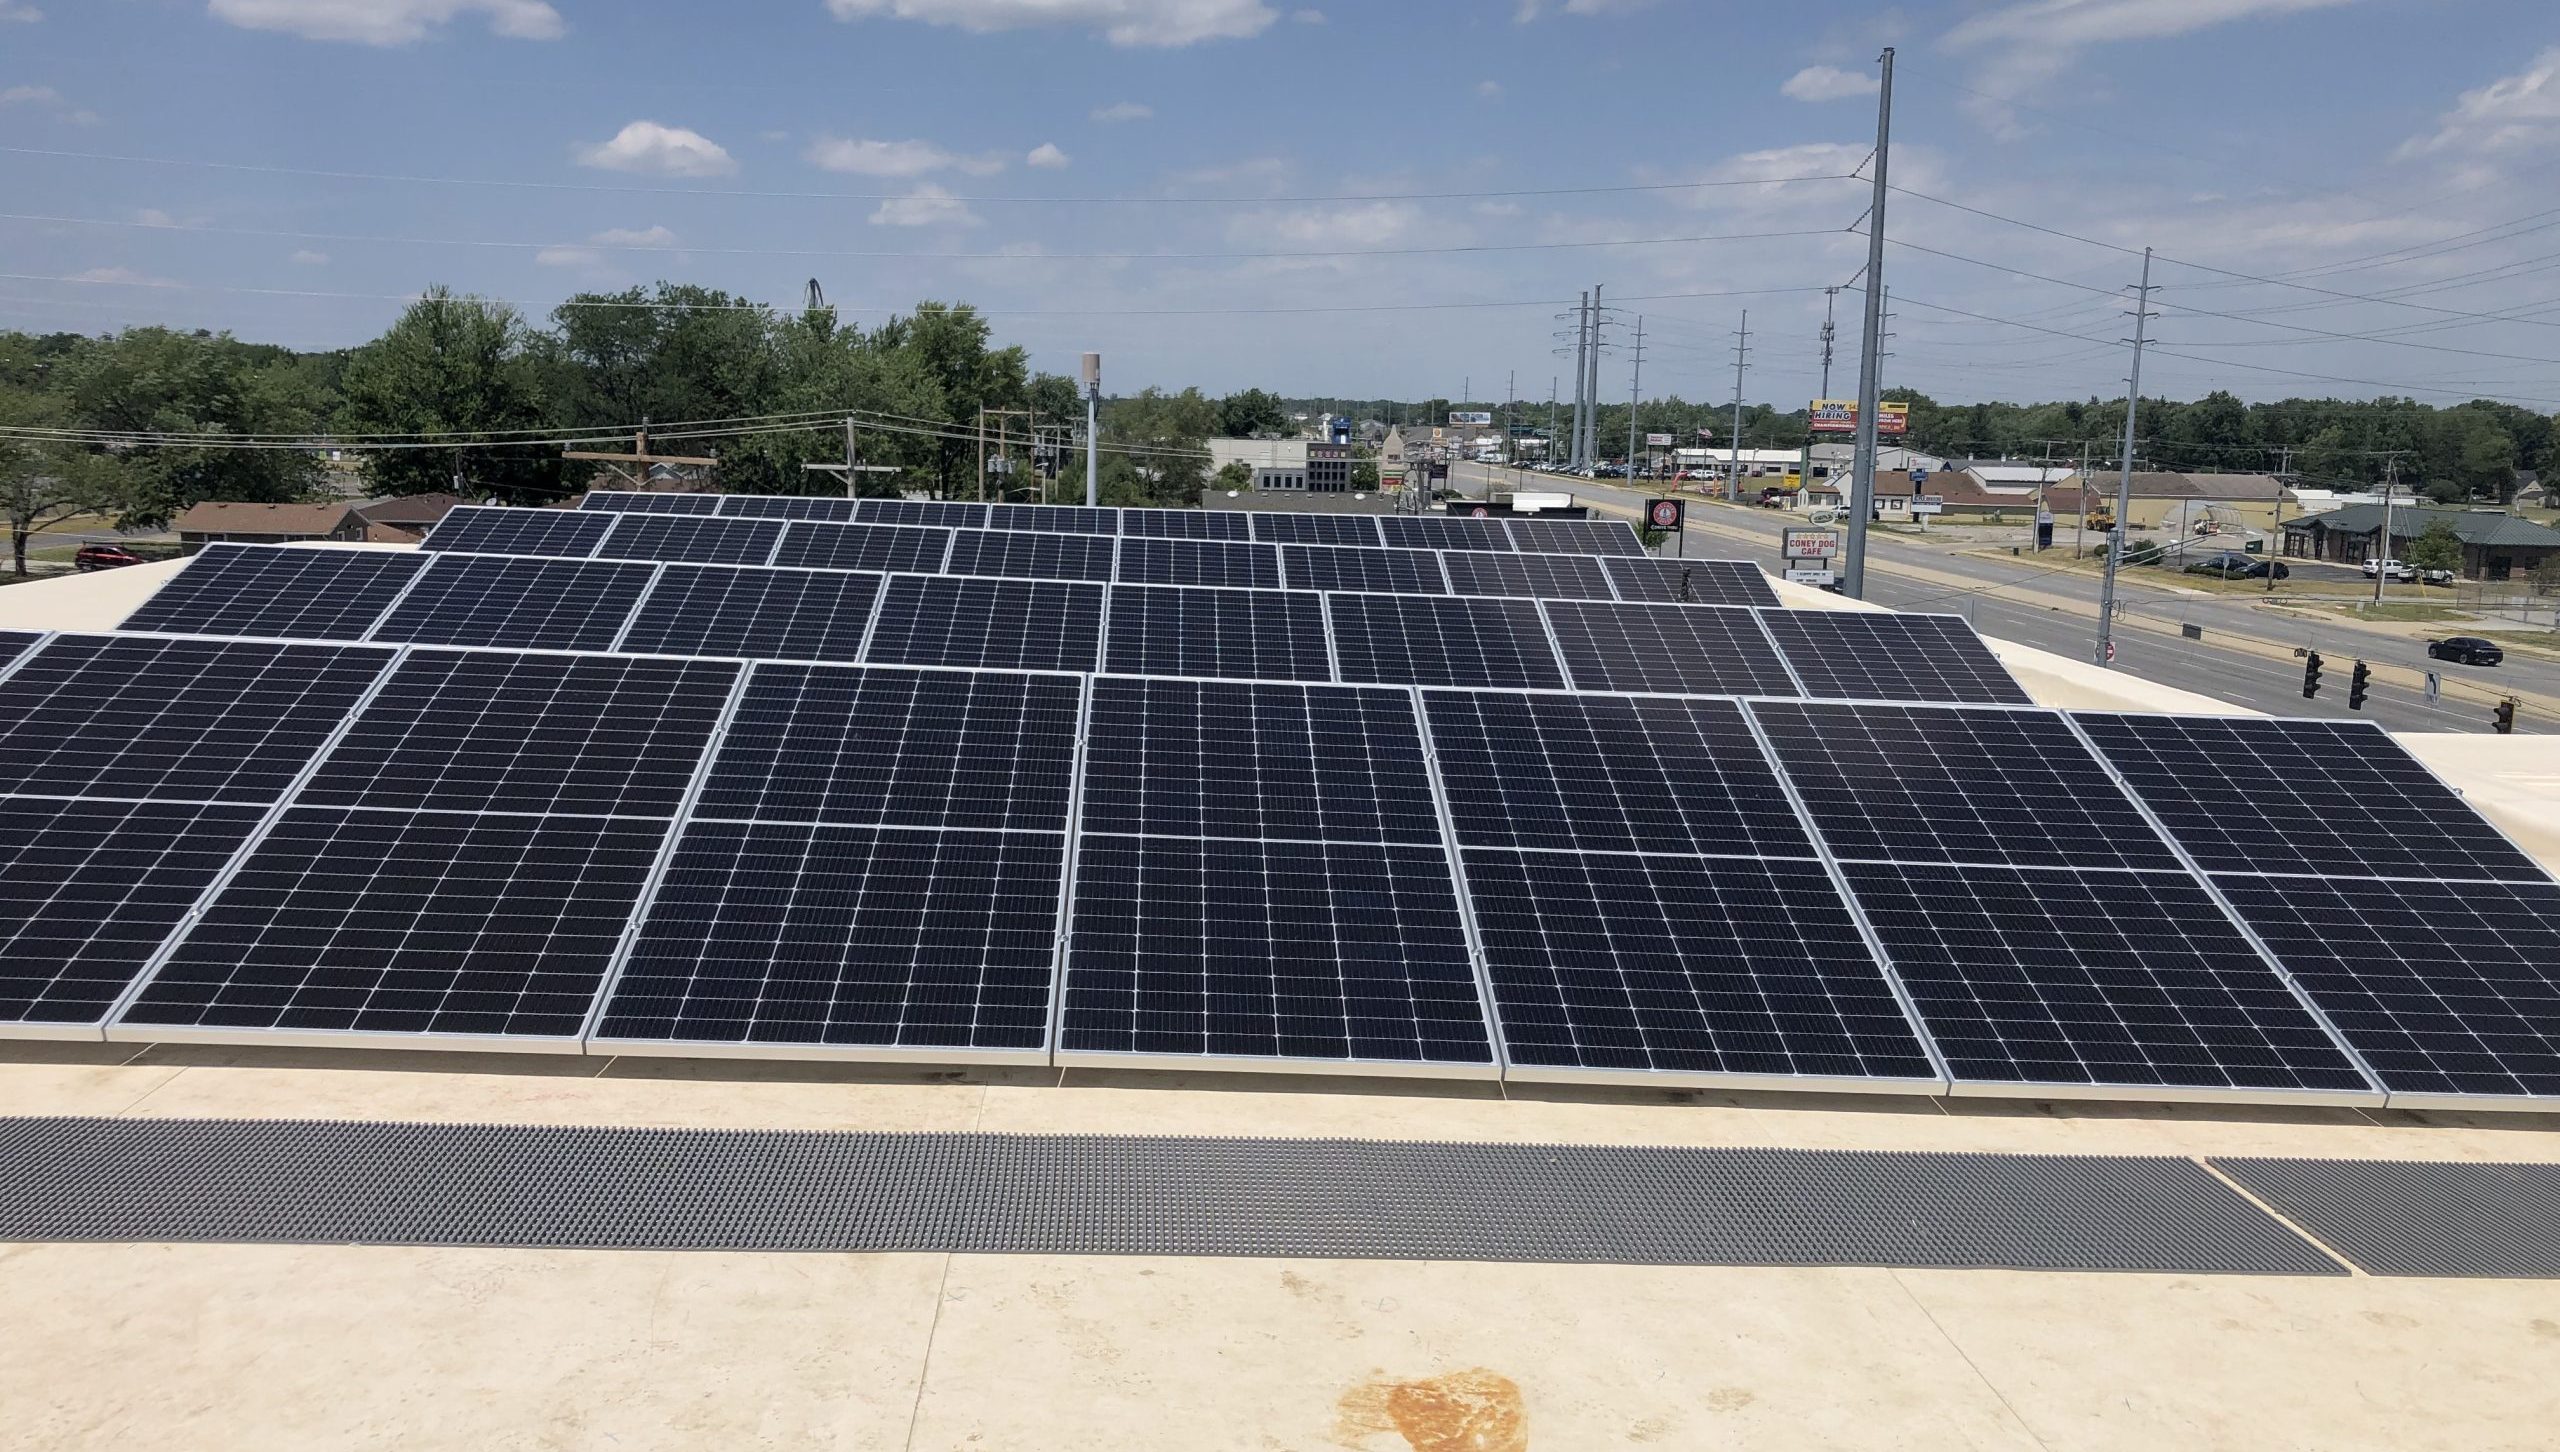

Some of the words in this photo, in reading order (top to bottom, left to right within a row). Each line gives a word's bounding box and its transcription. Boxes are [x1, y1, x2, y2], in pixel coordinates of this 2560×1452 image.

[1821, 403, 1846, 411] NOW
[1814, 411, 1851, 420] HIRING
[1789, 539, 1817, 548] CONEY
[1818, 540, 1835, 548] DOG
